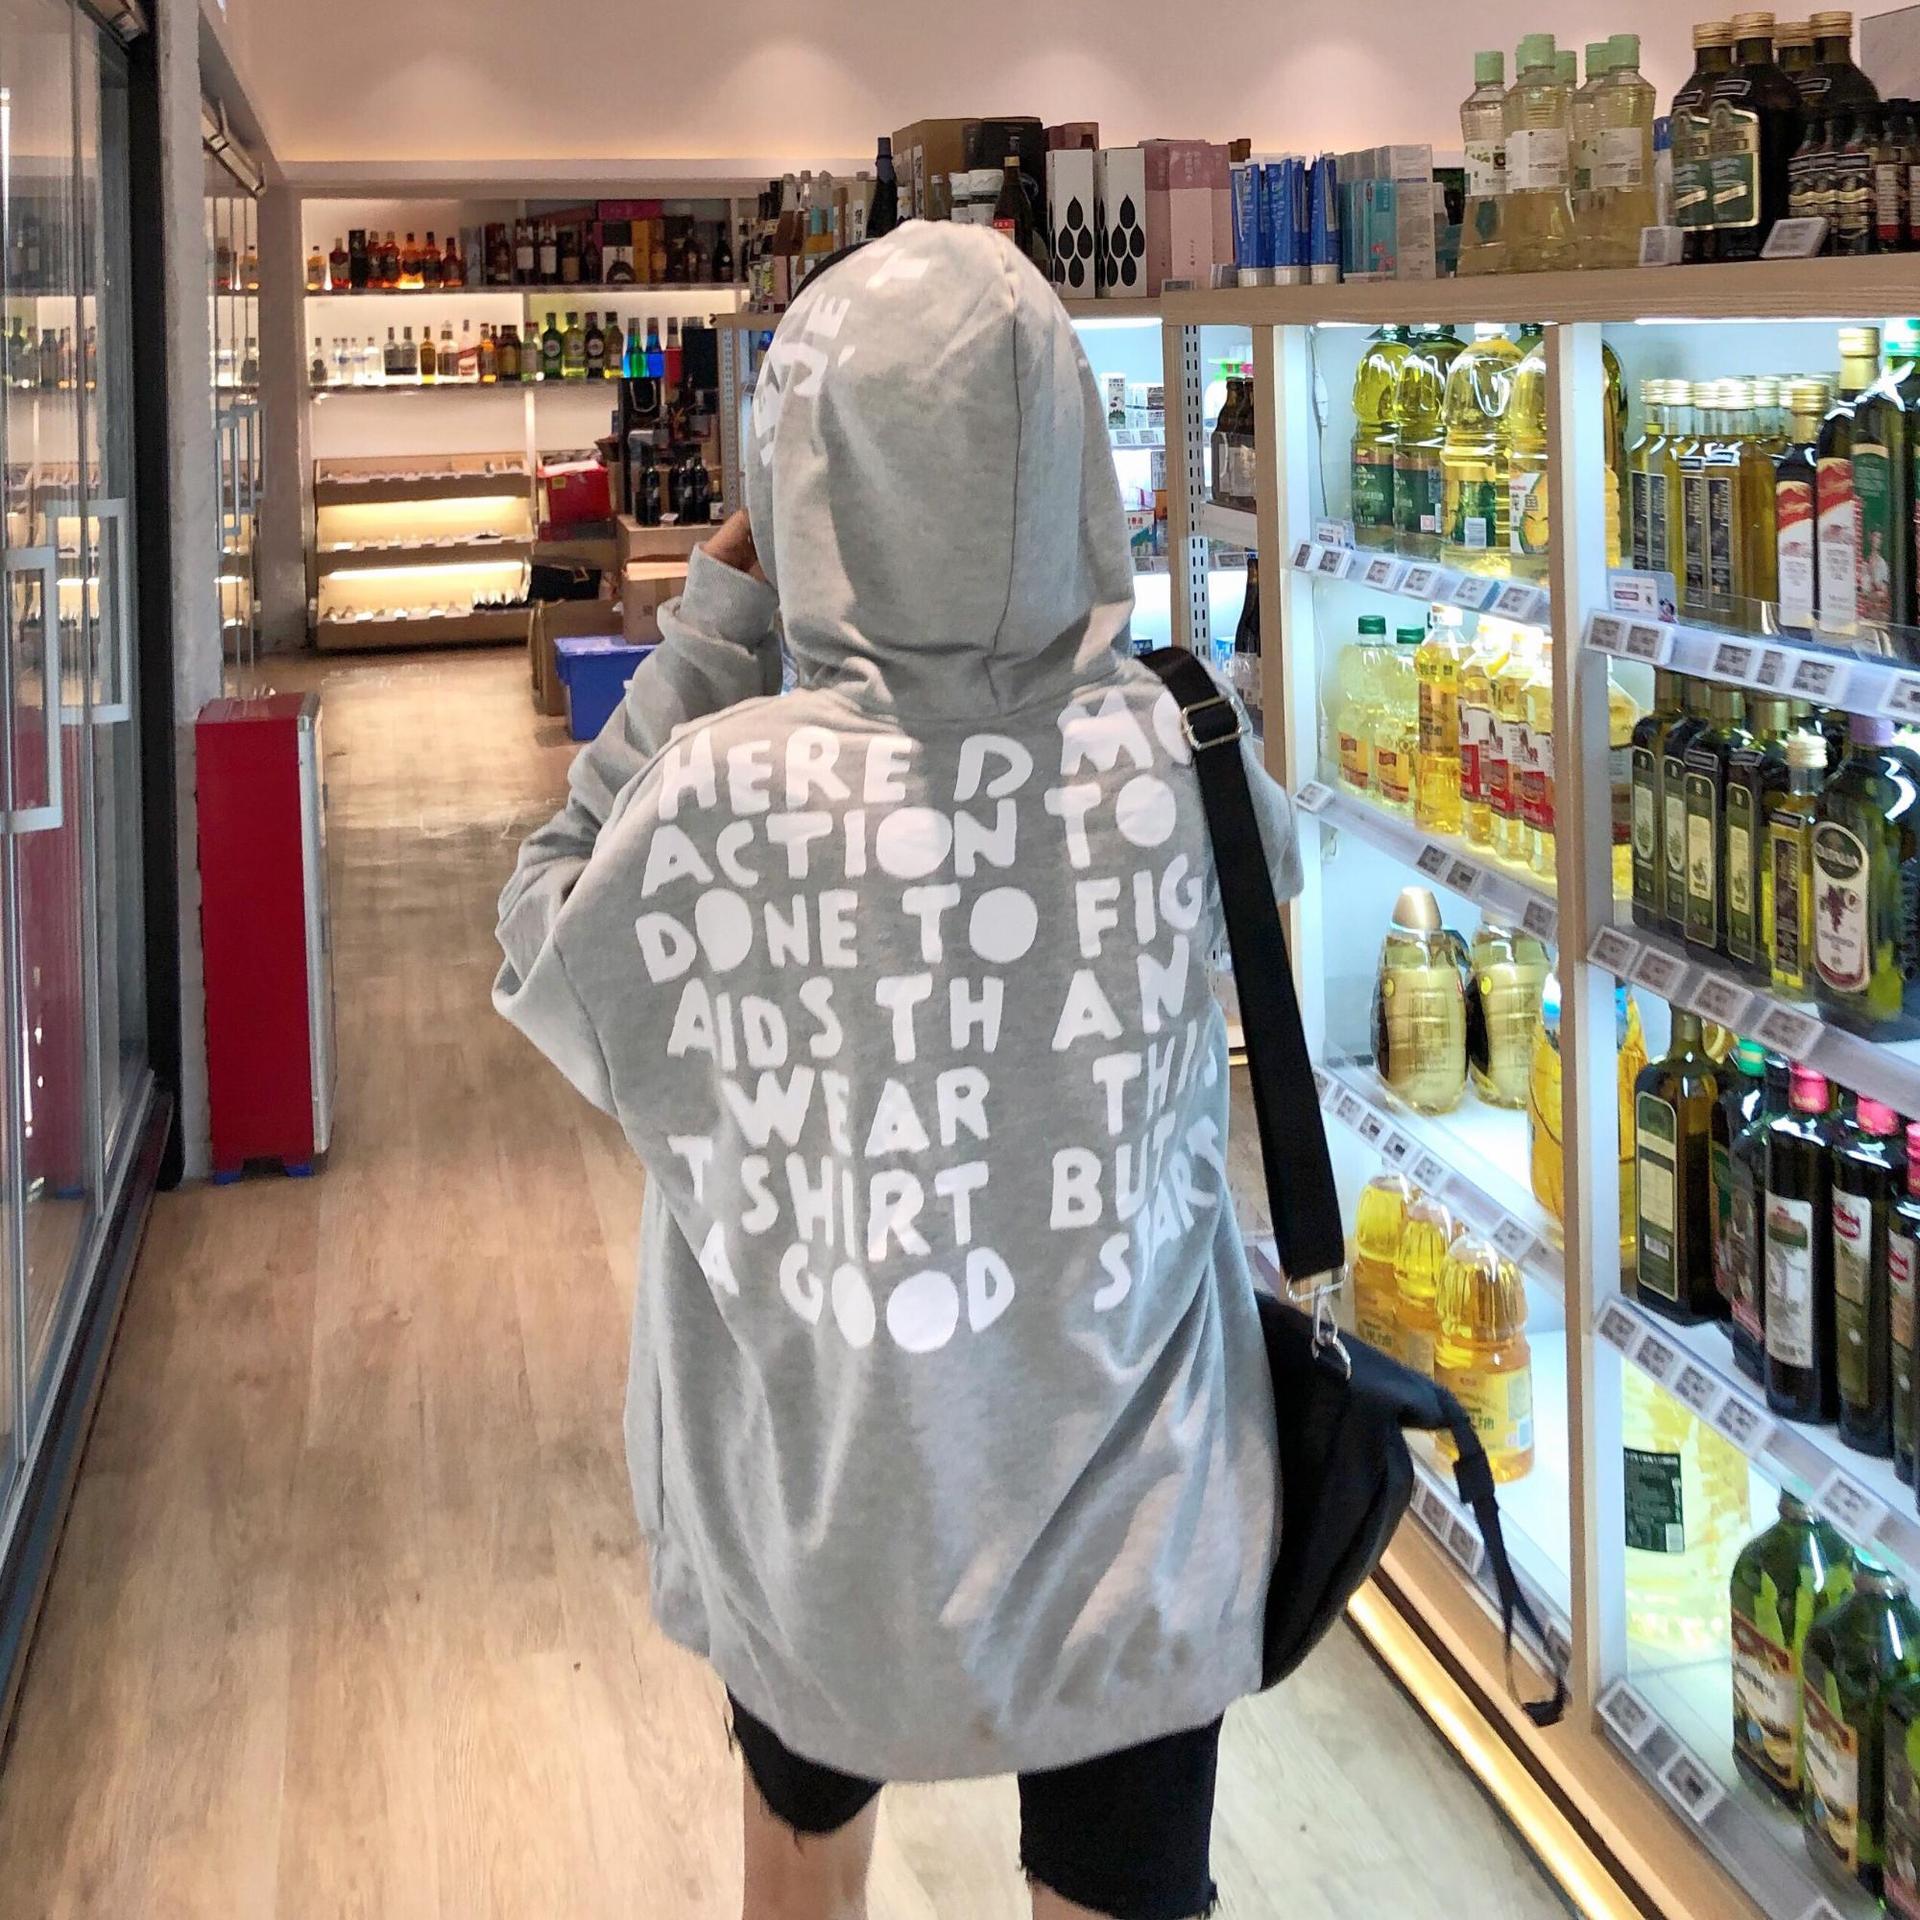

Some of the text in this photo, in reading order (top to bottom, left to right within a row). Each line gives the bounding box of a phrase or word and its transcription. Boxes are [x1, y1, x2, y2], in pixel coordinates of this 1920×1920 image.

[658, 726, 914, 820] HERE
[641, 774, 1177, 898] ACTION TO
[635, 888, 858, 983] DONE
[902, 884, 1038, 963] TO
[666, 976, 843, 1072] AIDS
[721, 1064, 991, 1157] WEAR
[741, 1152, 990, 1263] SHIRT
[1050, 1111, 1177, 1231] BUT
[699, 1229, 740, 1297] A
[780, 1243, 1016, 1353] GOOD
